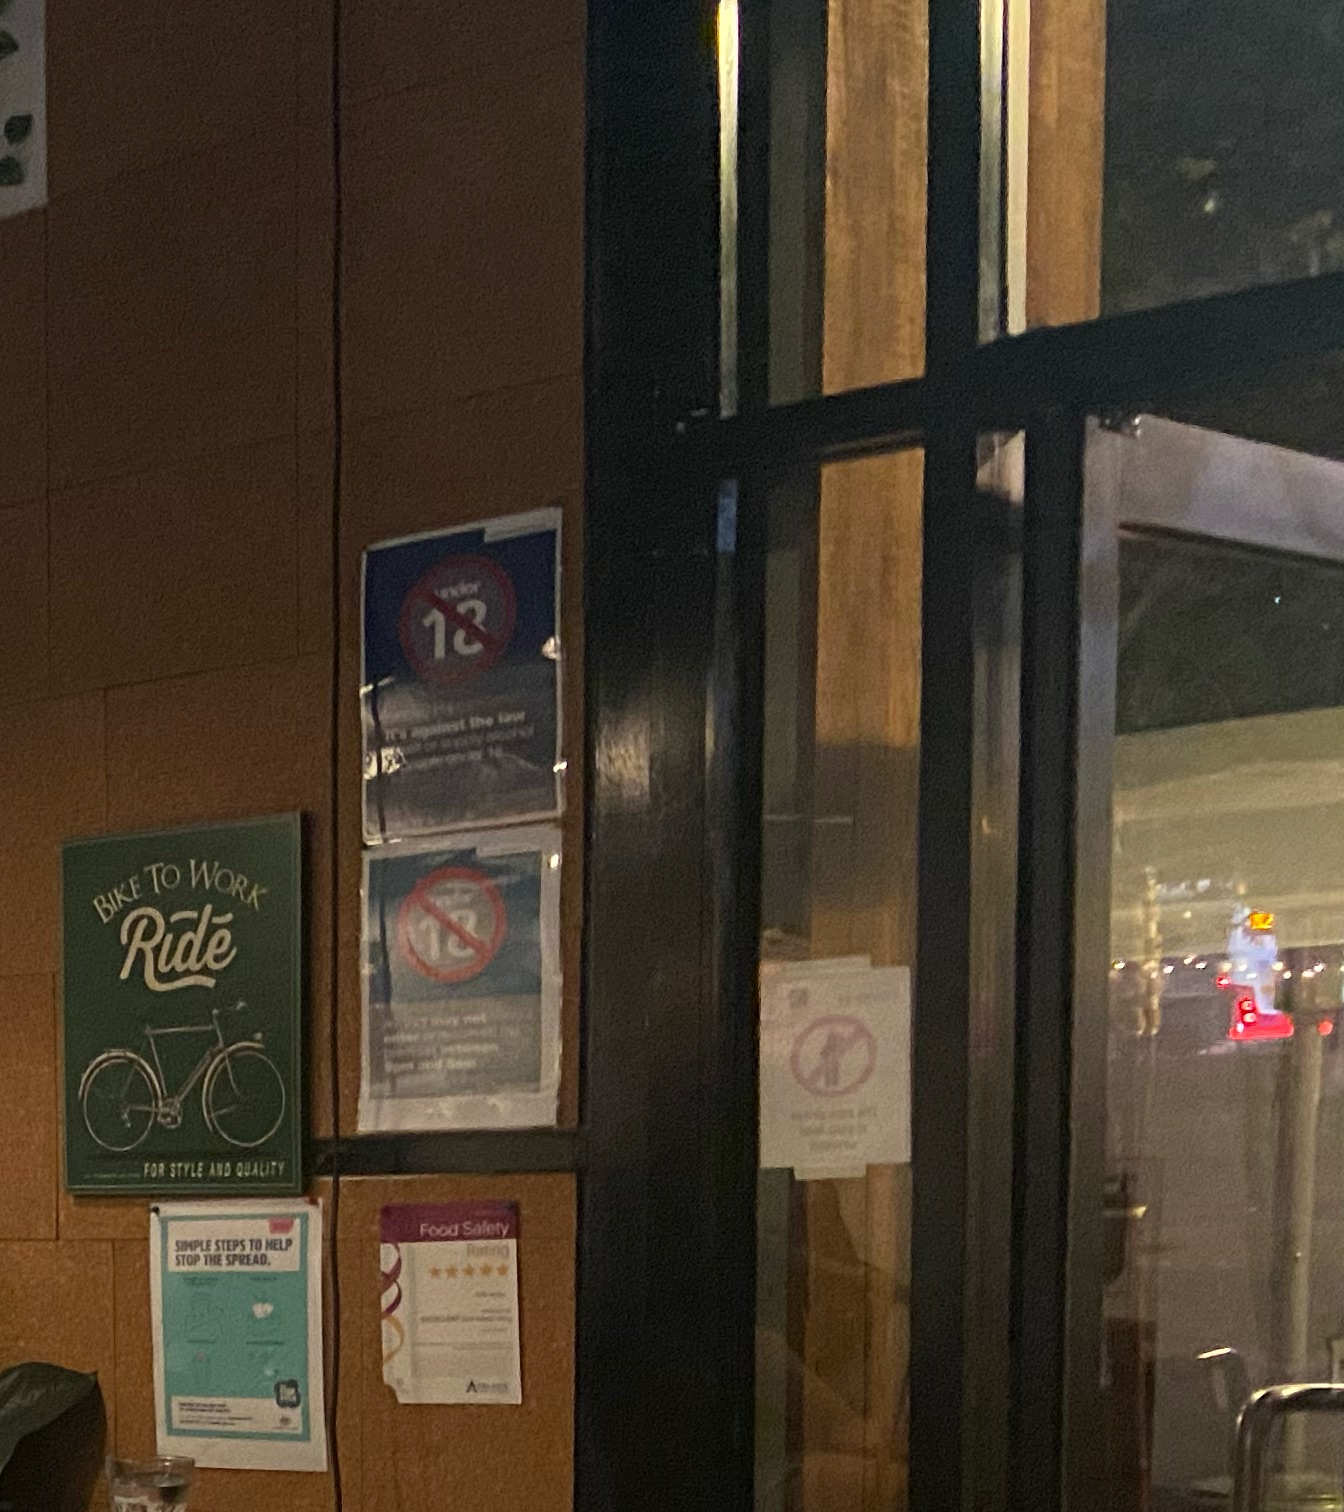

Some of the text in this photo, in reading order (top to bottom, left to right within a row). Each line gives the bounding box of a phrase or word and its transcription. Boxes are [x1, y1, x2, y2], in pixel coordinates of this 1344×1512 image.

[422, 598, 487, 659] 18
[410, 718, 466, 741] against
[469, 714, 494, 729] the
[498, 710, 526, 725] law
[93, 859, 267, 924] BIKE TO WORK
[120, 904, 237, 992] Ride
[419, 909, 477, 960] 18
[143, 1162, 165, 1178] FOR
[169, 1162, 204, 1178] STYLE
[208, 1161, 231, 1177] AND
[236, 1161, 286, 1177] QUALITY
[419, 1219, 510, 1238] Food Safety
[175, 1238, 293, 1253] SIMPLE STEPS TO HELP
[175, 1252, 271, 1266] STOP THE SPREAD.
